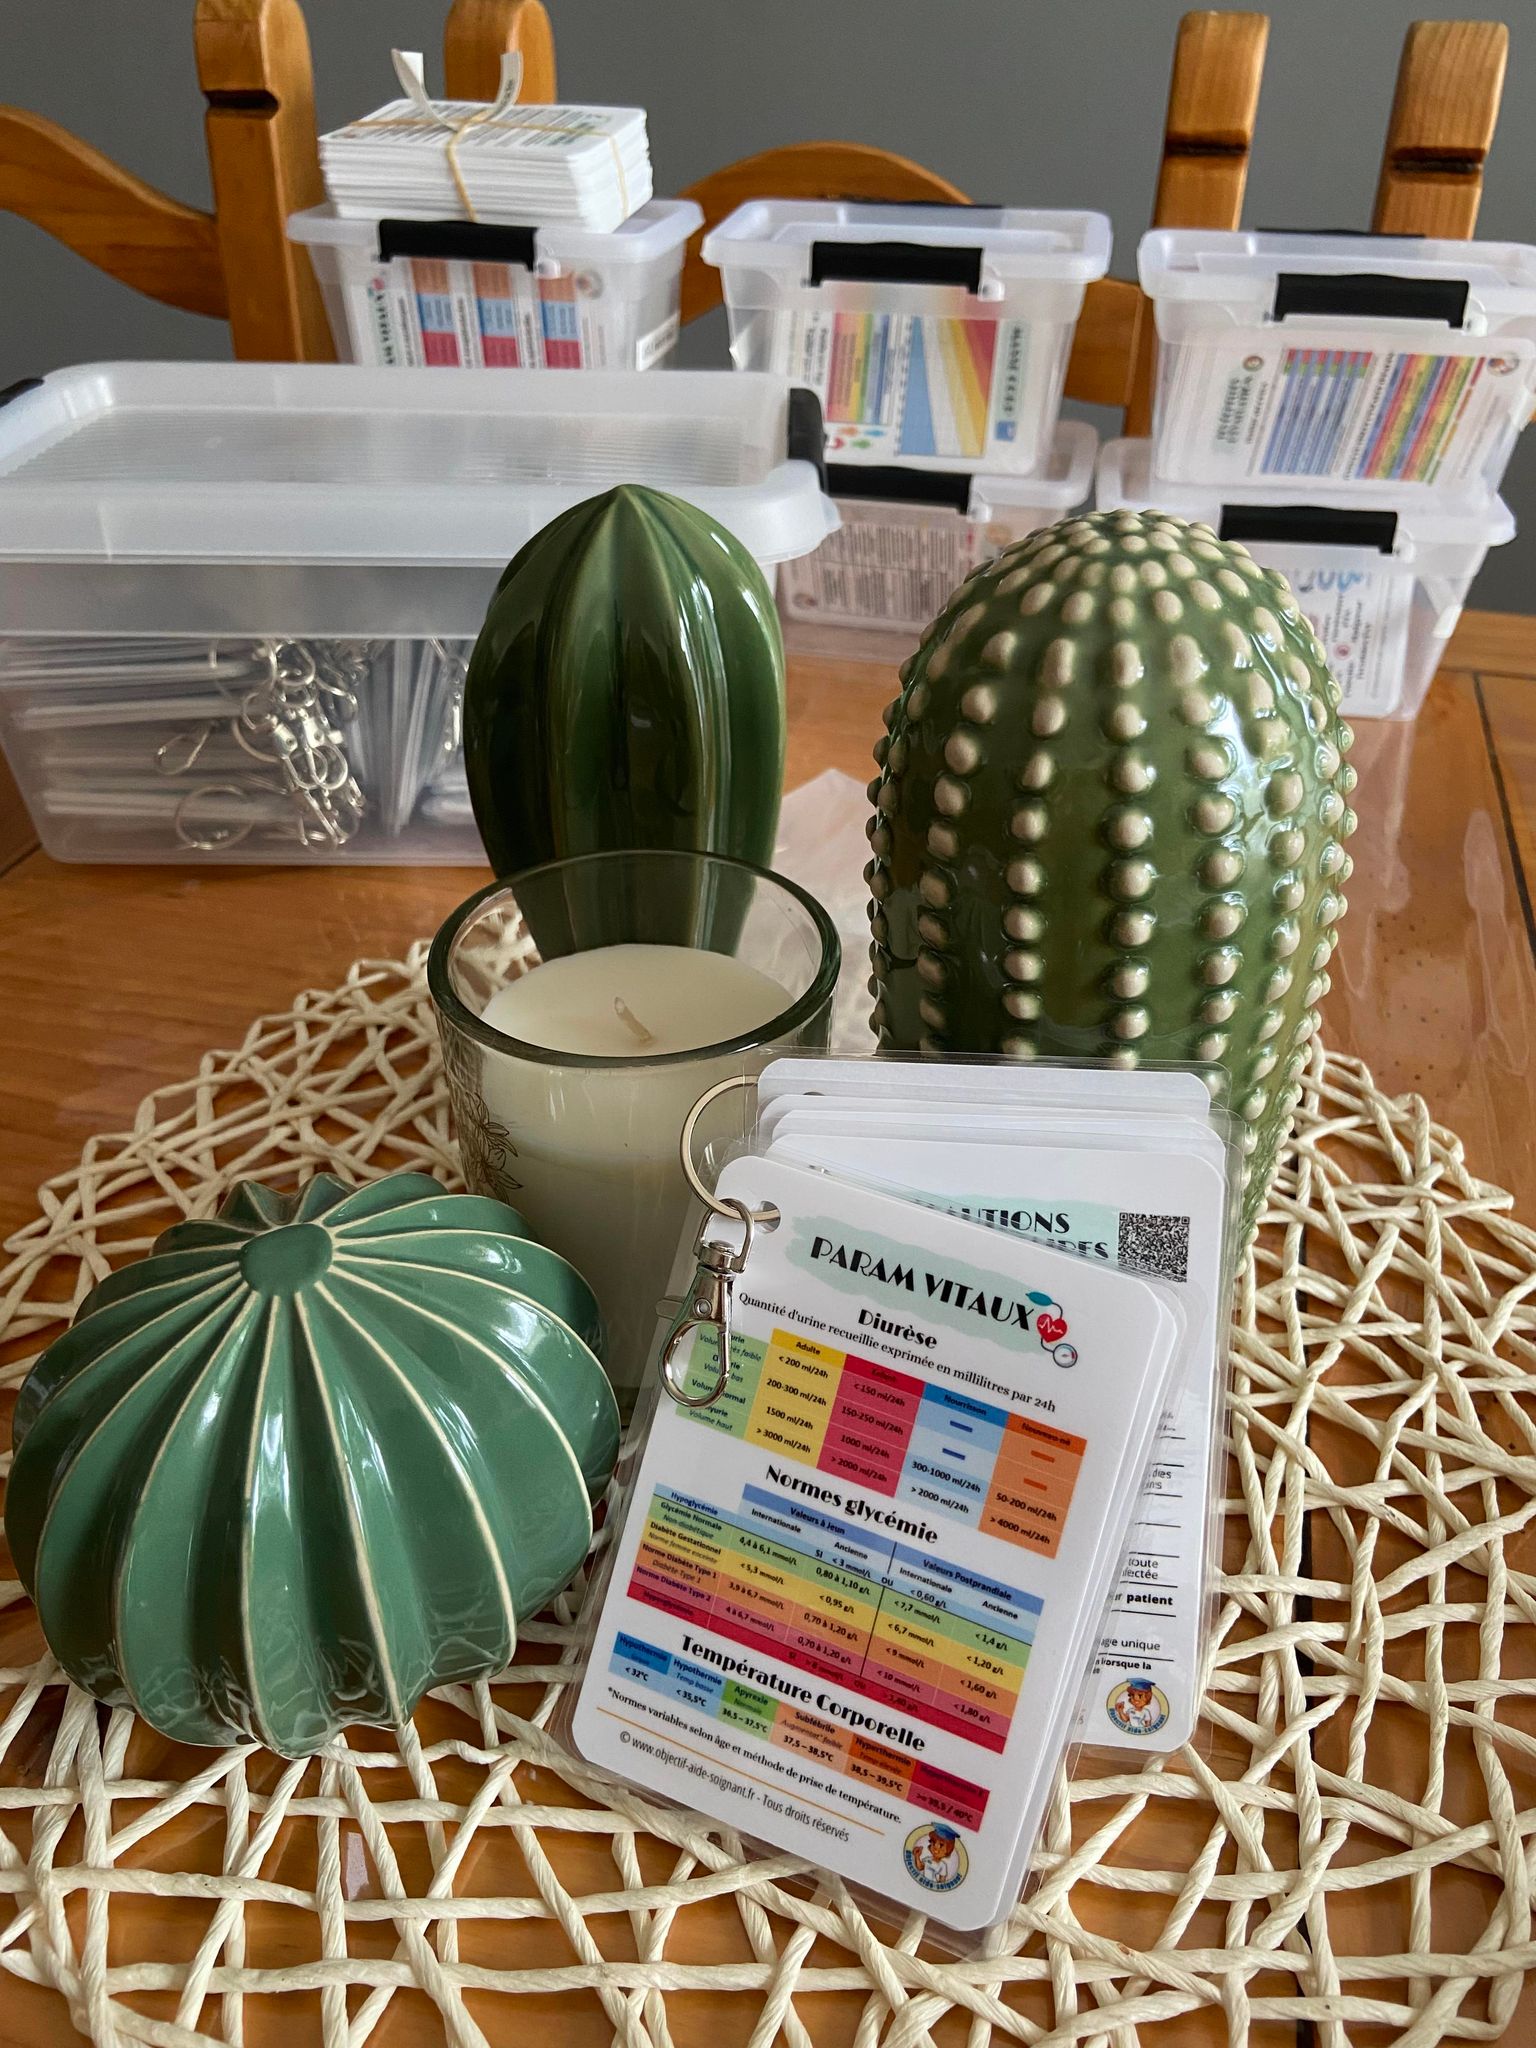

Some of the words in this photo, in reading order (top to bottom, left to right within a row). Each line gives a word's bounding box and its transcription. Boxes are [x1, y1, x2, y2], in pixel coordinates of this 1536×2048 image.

[810, 1236, 914, 1291] PARAM
[925, 1273, 1033, 1330] VITAUX
[858, 1308, 936, 1348] Diurèse
[738, 1293, 785, 1315] Quantité
[787, 1309, 826, 1329] d'urine
[828, 1325, 878, 1348] recueillie
[880, 1344, 934, 1368] exprimée
[936, 1364, 950, 1374] en
[953, 1369, 1009, 1394] millilitres
[1010, 1390, 1032, 1403] par
[1034, 1398, 1055, 1412] 24h
[795, 1341, 820, 1354] Adulte
[784, 1356, 800, 1367] 200
[801, 1364, 828, 1378] ml/24h
[766, 1378, 798, 1395] 200-300
[799, 1392, 826, 1406] ml/24h
[860, 1384, 876, 1395] 150
[841, 1405, 874, 1423] 150-250
[943, 1394, 986, 1415] Nourrisson
[689, 1409, 715, 1424] Volume
[715, 1419, 732, 1430] haut
[766, 1406, 785, 1418] 1500
[786, 1415, 813, 1429] ml/24h
[764, 1429, 782, 1442] 3000
[783, 1439, 810, 1452] ml/24h
[840, 1434, 860, 1447] 1000
[837, 1457, 858, 1471] 2000
[912, 1461, 950, 1480] 300-1000
[951, 1477, 980, 1492] ml/24h
[671, 1492, 717, 1515] Hypoglycémie
[766, 1465, 841, 1506] Normes
[844, 1499, 937, 1543] glycémie
[918, 1488, 939, 1501] 2000
[939, 1498, 968, 1513] ml/24h
[996, 1492, 1026, 1509] 50-200
[1026, 1506, 1056, 1521] ml/24h
[660, 1501, 691, 1518] Glycémie
[692, 1514, 721, 1530] Normale
[751, 1508, 801, 1532] Internationale
[790, 1507, 818, 1524] Valeurs
[826, 1521, 845, 1534] Jeun
[650, 1521, 676, 1536] Diabète
[677, 1532, 721, 1554] Gestationnel
[739, 1536, 751, 1546] 4,4
[997, 1518, 1019, 1531] 4000
[1020, 1529, 1050, 1544] ml/24h
[815, 1549, 823, 1558] SI
[834, 1541, 867, 1559] Ancienne
[746, 1563, 758, 1573] 5,3
[839, 1558, 844, 1566] 3
[815, 1566, 833, 1579] 0,80
[841, 1577, 858, 1589] 1,10
[881, 1576, 893, 1586] OU
[899, 1567, 952, 1593] Internationale
[923, 1559, 953, 1577] Valeurs
[954, 1571, 1011, 1600] Postprandiale
[825, 1595, 842, 1608] 0,95
[900, 1601, 913, 1611] 7,7
[916, 1590, 934, 1602] 0,60
[1126, 1593, 1173, 1605] patient
[803, 1612, 821, 1624] 0,70
[982, 1600, 1018, 1619] Ancienne
[893, 1623, 907, 1634] 6,7
[982, 1634, 995, 1645] 1,4
[1121, 1640, 1161, 1651] unique
[673, 1658, 721, 1685] Hypothermie
[973, 1656, 991, 1669] 1,20
[631, 1668, 648, 1681] 32°C
[682, 1635, 811, 1702] Température
[816, 1694, 924, 1750] Corporelle
[682, 1690, 706, 1706] 35,5°C
[795, 1711, 835, 1733] Subfébrile
[783, 1734, 800, 1747] 37,5
[807, 1745, 833, 1761] 38,5°C
[648, 1707, 687, 1729] variables
[689, 1726, 713, 1741] selon
[714, 1735, 730, 1749] âge
[731, 1745, 741, 1754] et
[743, 1749, 784, 1772] méthode
[785, 1767, 798, 1777] de
[798, 1774, 823, 1788] prise
[824, 1783, 837, 1794] de
[838, 1790, 900, 1823] température.
[632, 1738, 754, 1799] www.objectif-aide-soignant.fr
[762, 1794, 783, 1813] Tous
[784, 1805, 810, 1824] droits
[811, 1817, 849, 1841] réservés
